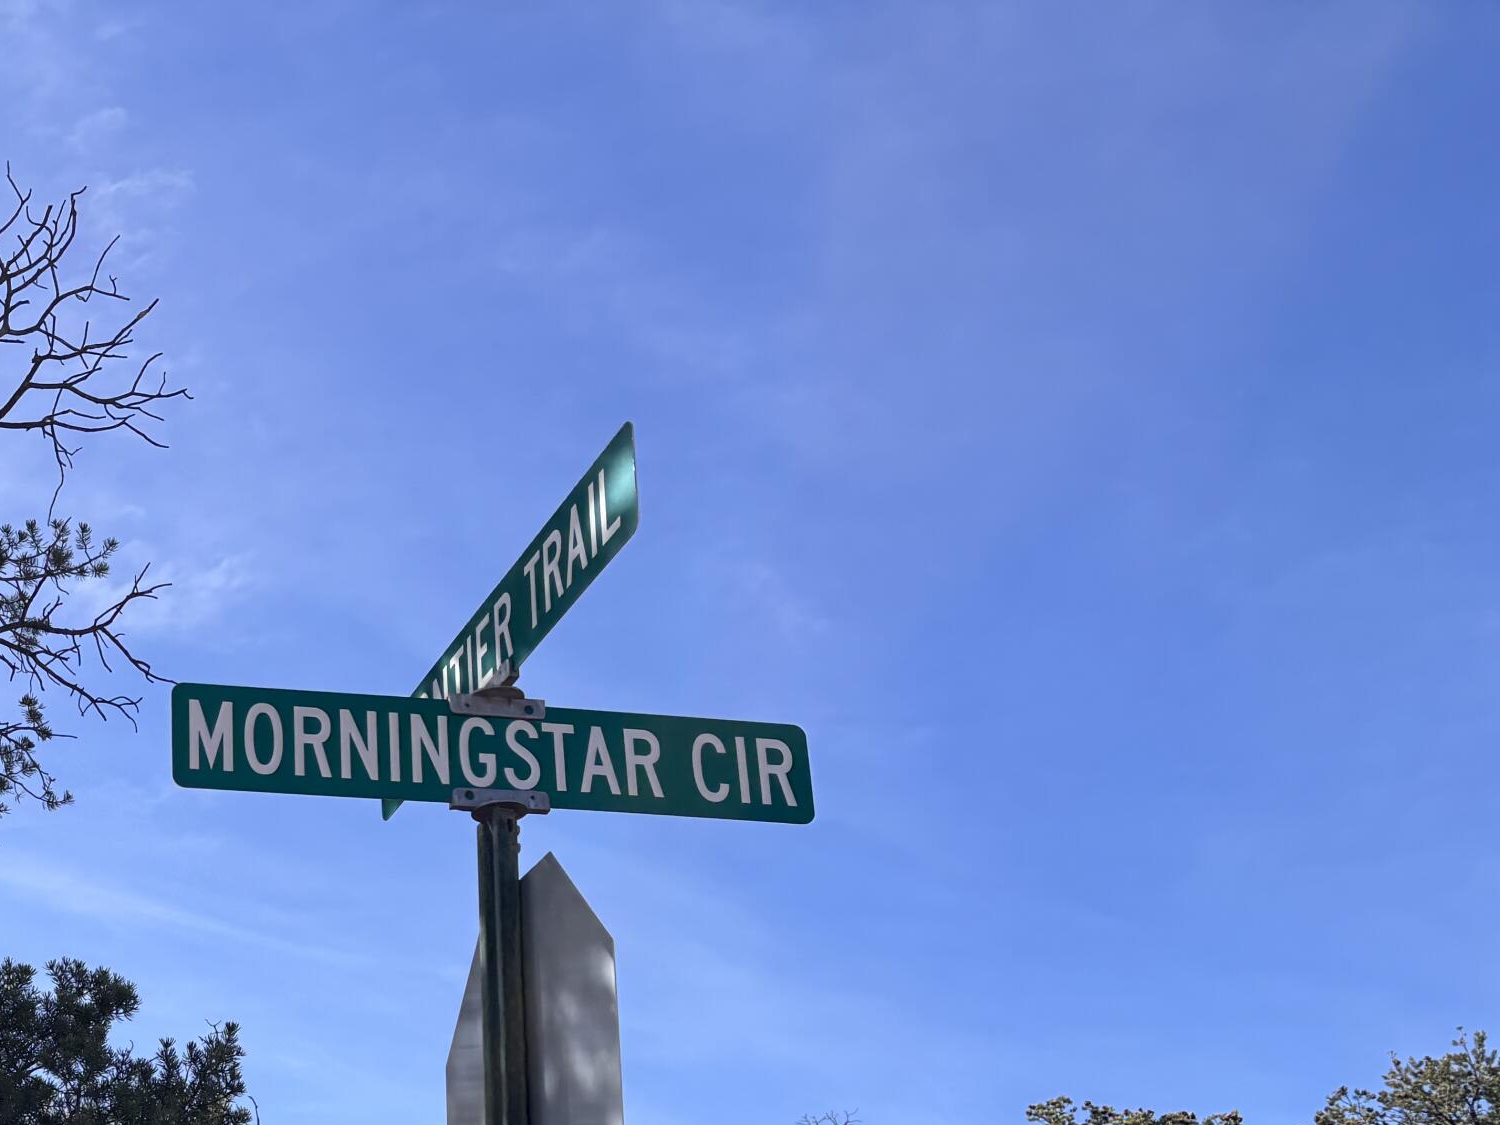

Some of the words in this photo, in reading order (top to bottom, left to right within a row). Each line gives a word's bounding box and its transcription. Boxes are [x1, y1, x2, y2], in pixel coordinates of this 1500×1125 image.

[524, 469, 621, 629] TRAIL
[188, 699, 665, 799] MORNINGSTAR
[692, 733, 798, 807] CIR
